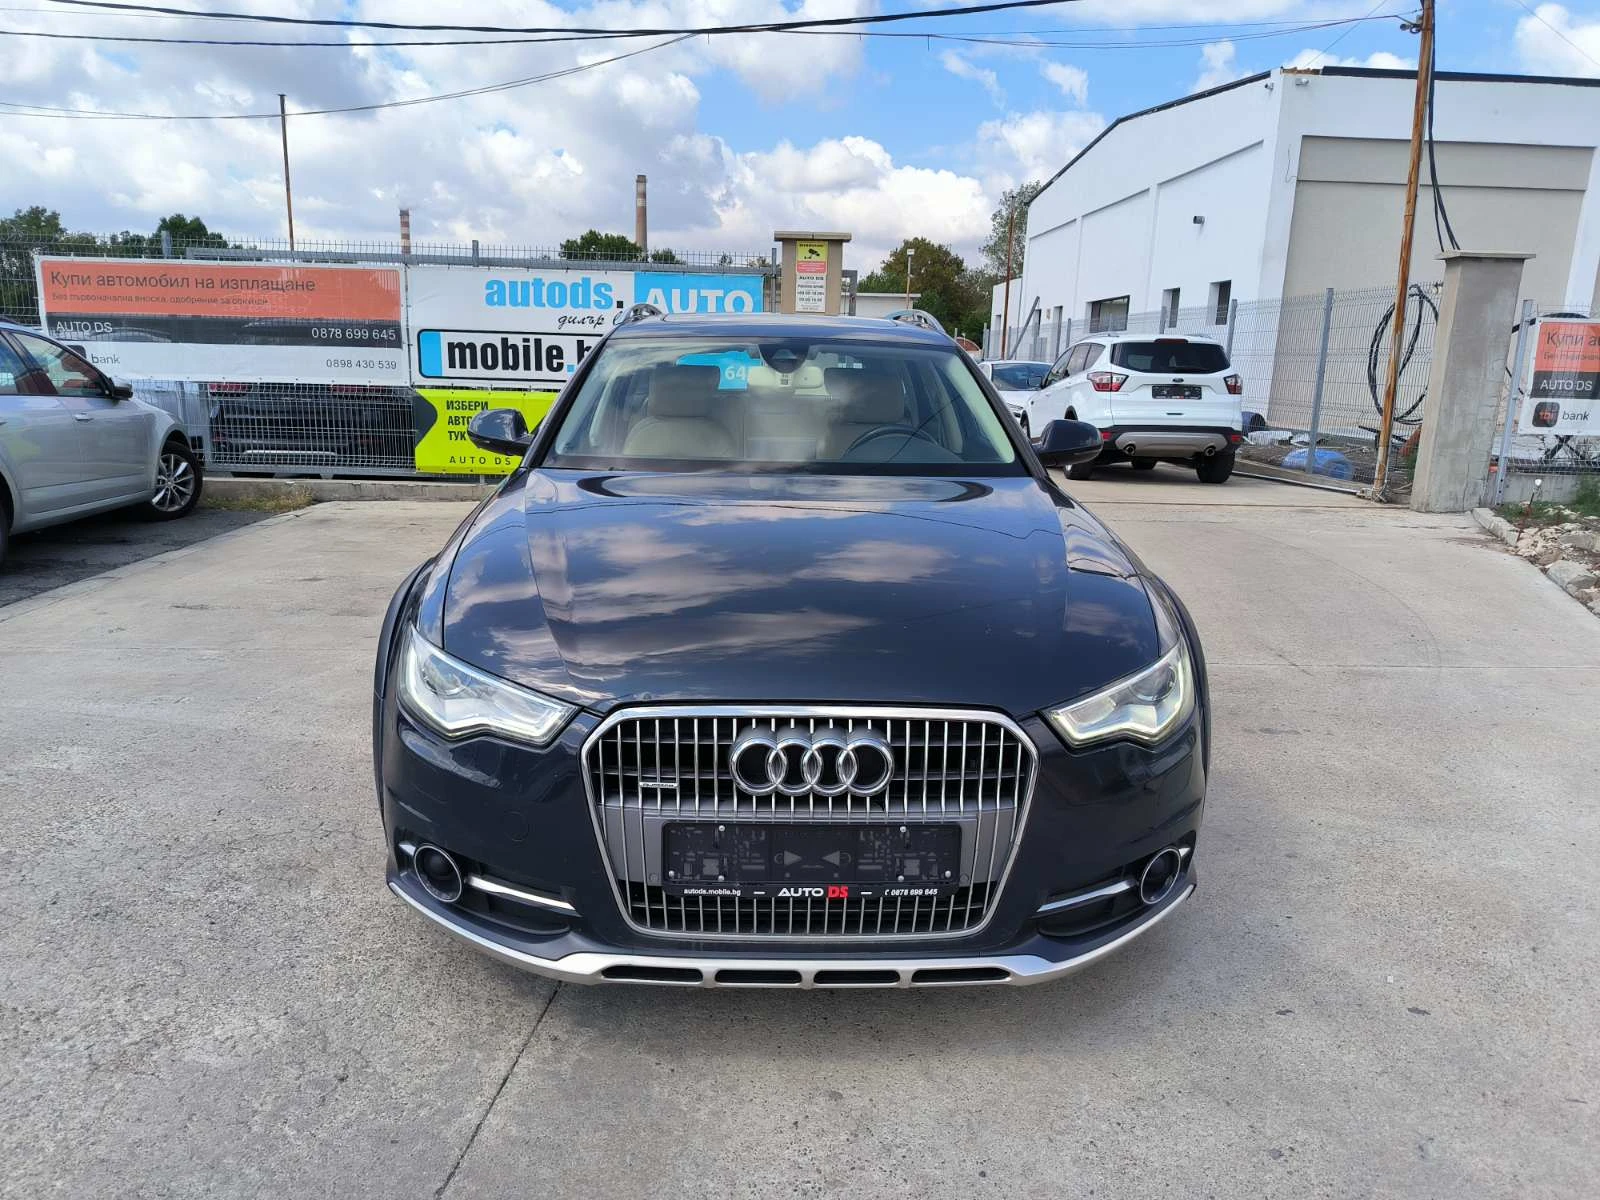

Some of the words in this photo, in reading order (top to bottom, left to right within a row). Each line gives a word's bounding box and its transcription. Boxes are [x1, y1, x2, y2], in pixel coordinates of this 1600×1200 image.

[51, 271, 91, 288] Купи
[97, 273, 189, 288] автомобил
[195, 278, 215, 289] на
[220, 279, 316, 292] изплащане
[646, 288, 754, 313] AUTO
[56, 321, 92, 332] AUTO
[94, 322, 113, 333] DS
[558, 314, 605, 329] дилър
[312, 327, 342, 339] 0878
[346, 328, 369, 340] 699
[372, 329, 396, 340] 645
[1546, 331, 1584, 348] Купи
[91, 353, 121, 364] bank
[326, 359, 353, 368] 0898
[355, 359, 375, 369] 430
[378, 360, 397, 370] 539
[724, 366, 746, 381] 64
[1540, 380, 1573, 391] AUTO
[1575, 380, 1593, 391] DS
[446, 400, 489, 411] ИЗБЕРИ
[1562, 410, 1590, 421] bank
[448, 430, 467, 441] ТУК
[449, 455, 486, 465] AUTO
[494, 457, 511, 466] DS
[683, 888, 741, 897] autods.mobile.bg
[778, 887, 824, 897] AUTO
[827, 886, 849, 898] DS
